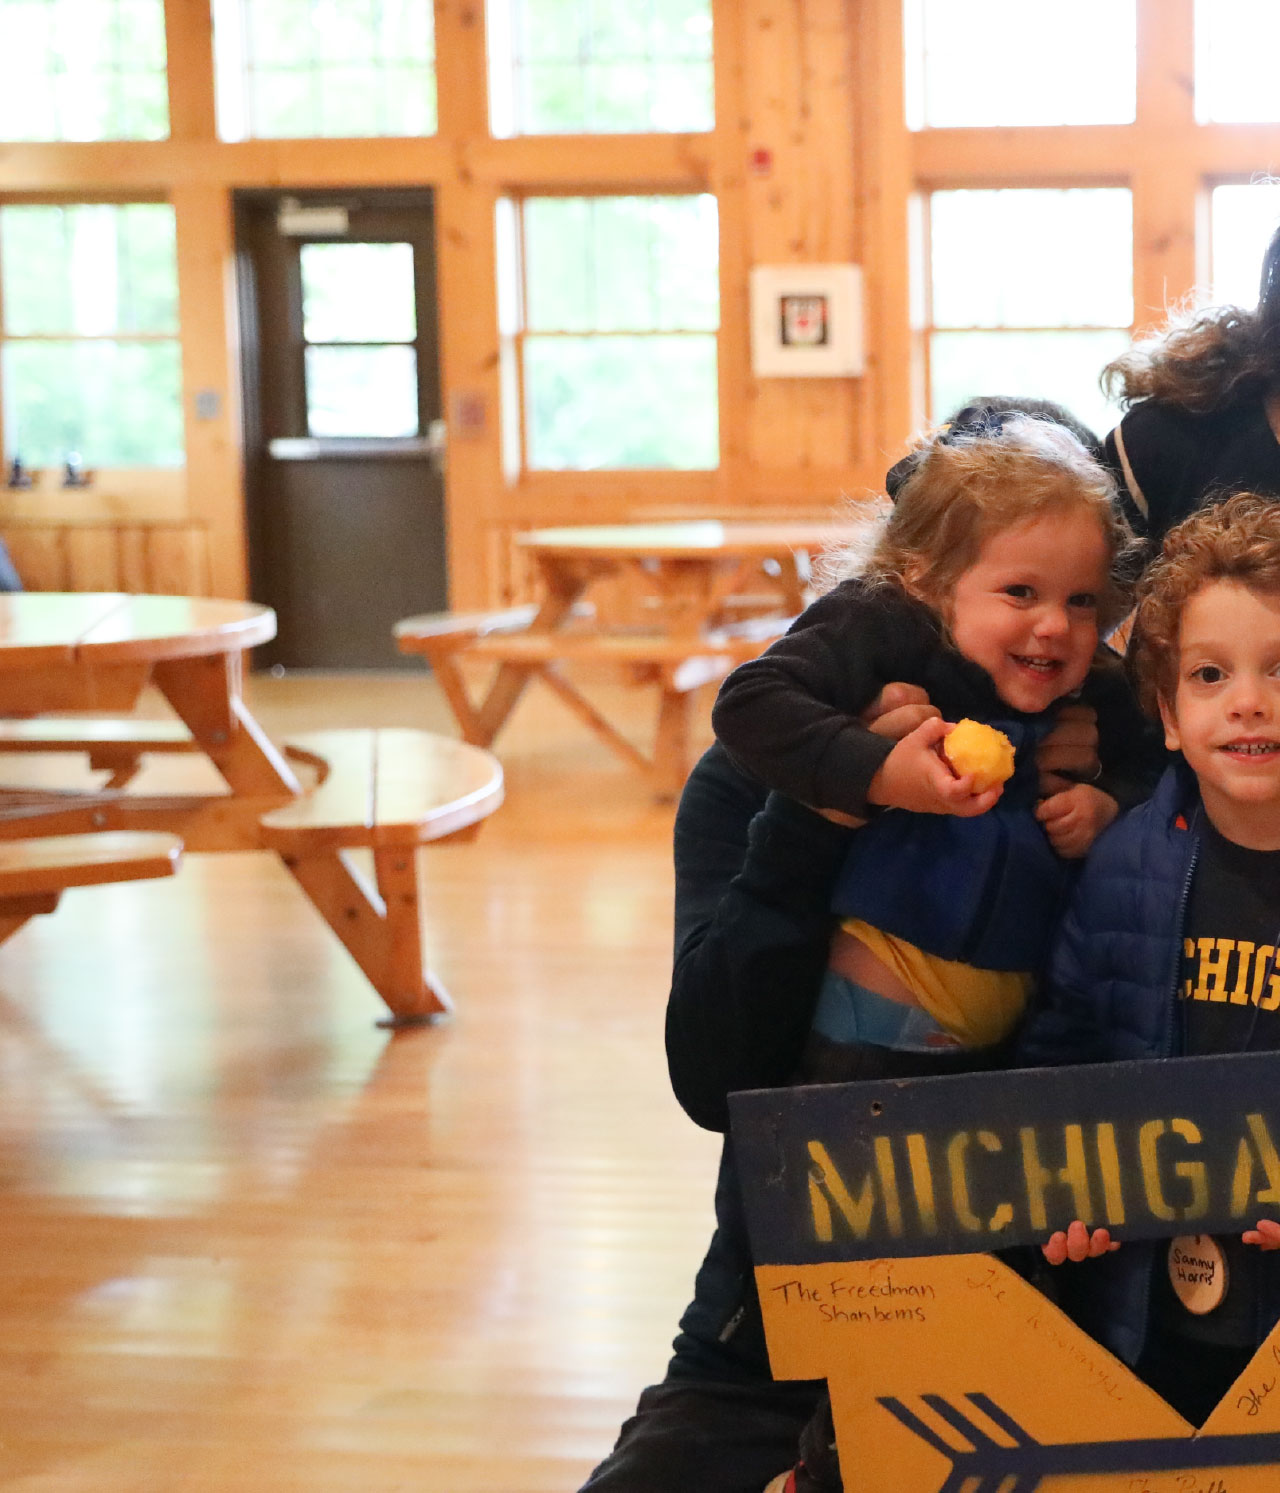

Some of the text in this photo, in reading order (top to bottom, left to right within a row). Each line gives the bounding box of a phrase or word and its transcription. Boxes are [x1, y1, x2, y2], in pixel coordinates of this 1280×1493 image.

[1174, 1248, 1215, 1278] Sammy
[1178, 1267, 1213, 1286] Harris
[772, 1276, 936, 1305] The Freedman
[1237, 1377, 1276, 1416] The
